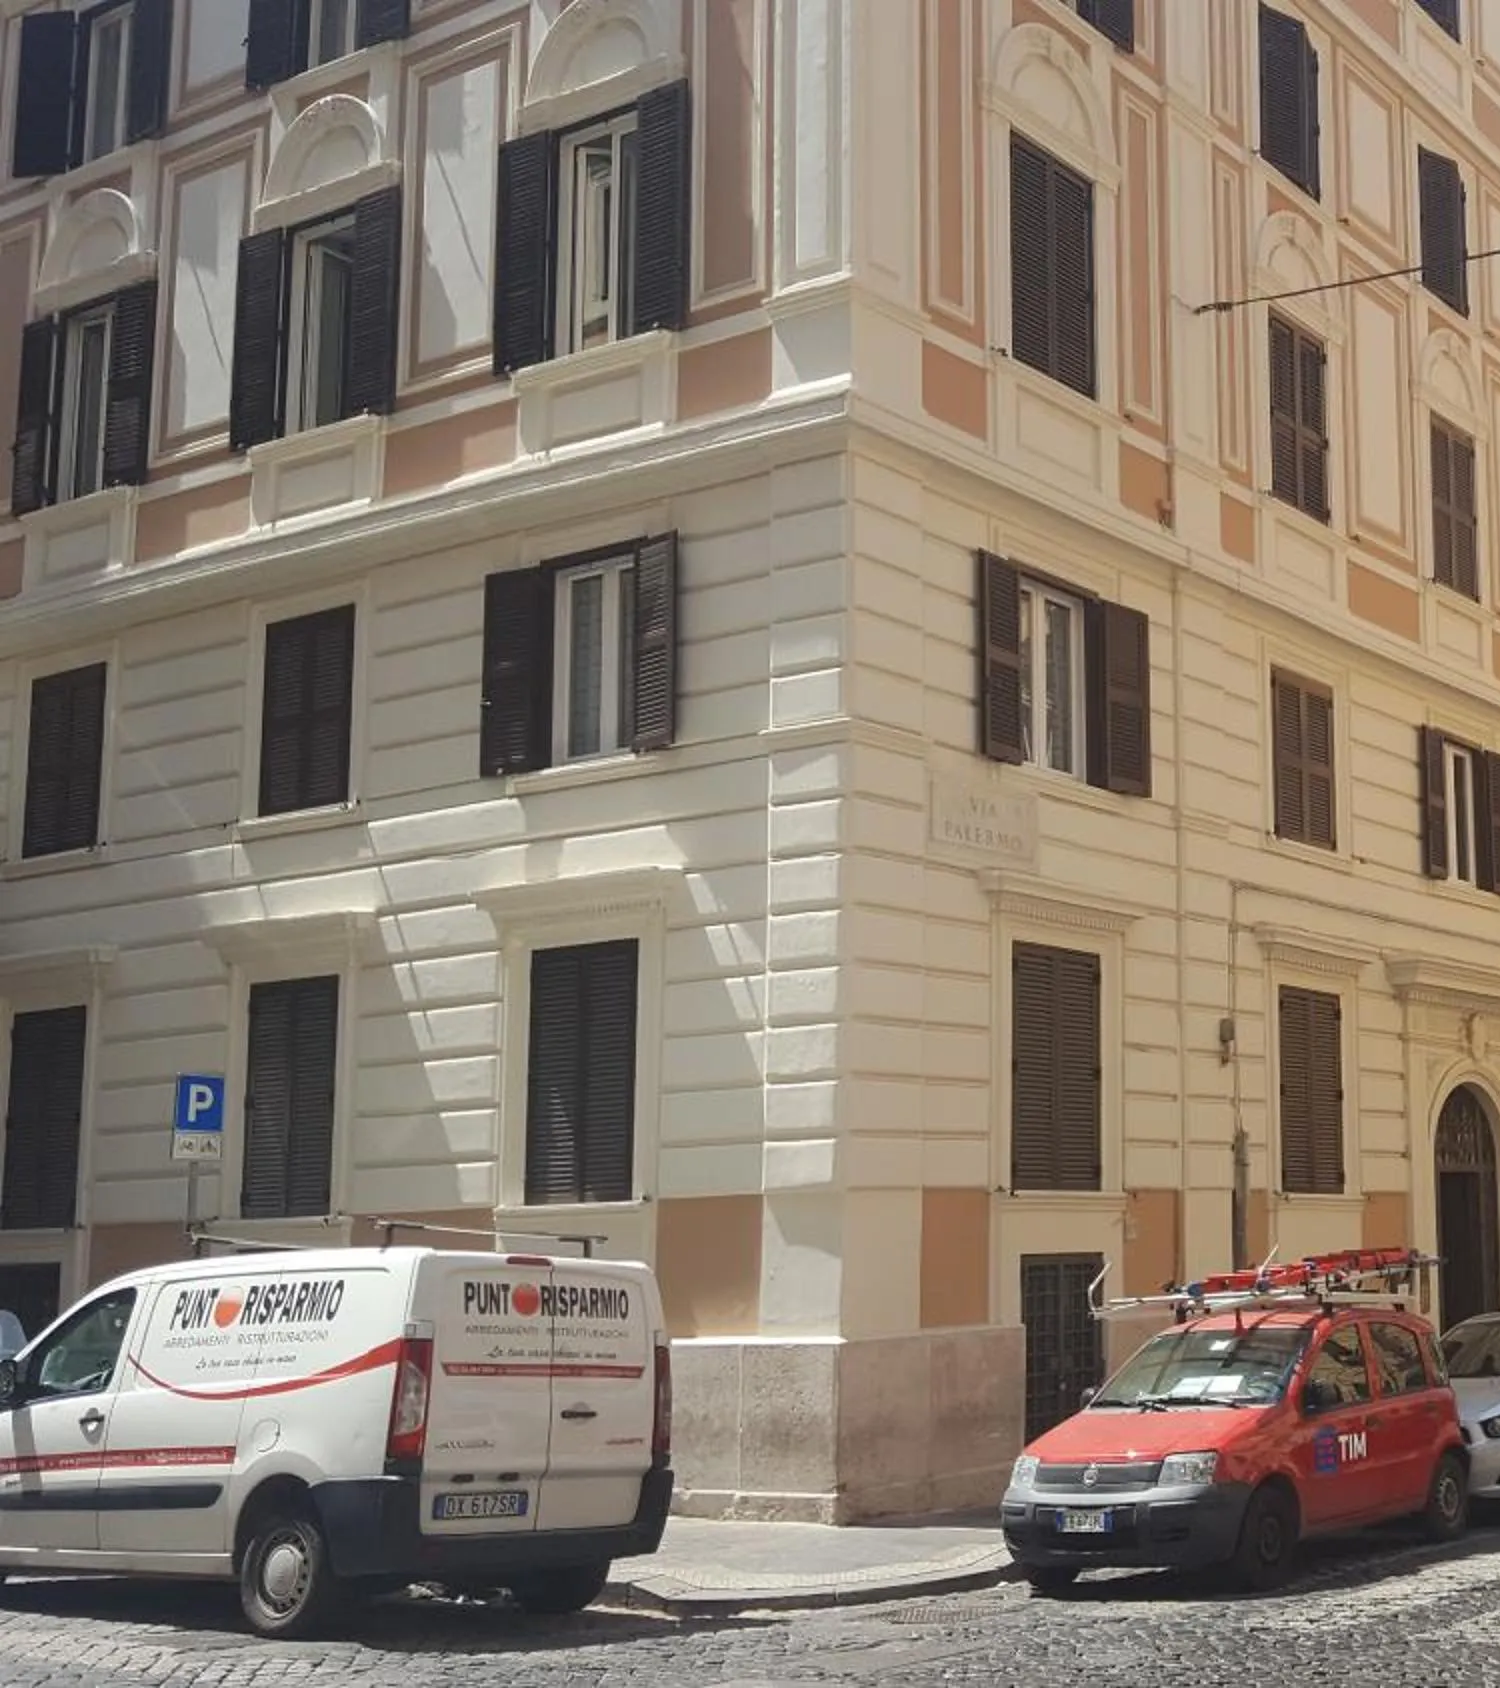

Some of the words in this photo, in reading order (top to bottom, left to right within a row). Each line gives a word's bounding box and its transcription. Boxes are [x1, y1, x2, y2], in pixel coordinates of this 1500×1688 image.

[187, 1083, 215, 1123] P
[240, 1279, 345, 1326] RISPARMIO
[540, 1285, 629, 1320] RISPARMIO
[1337, 1431, 1367, 1462] TIM
